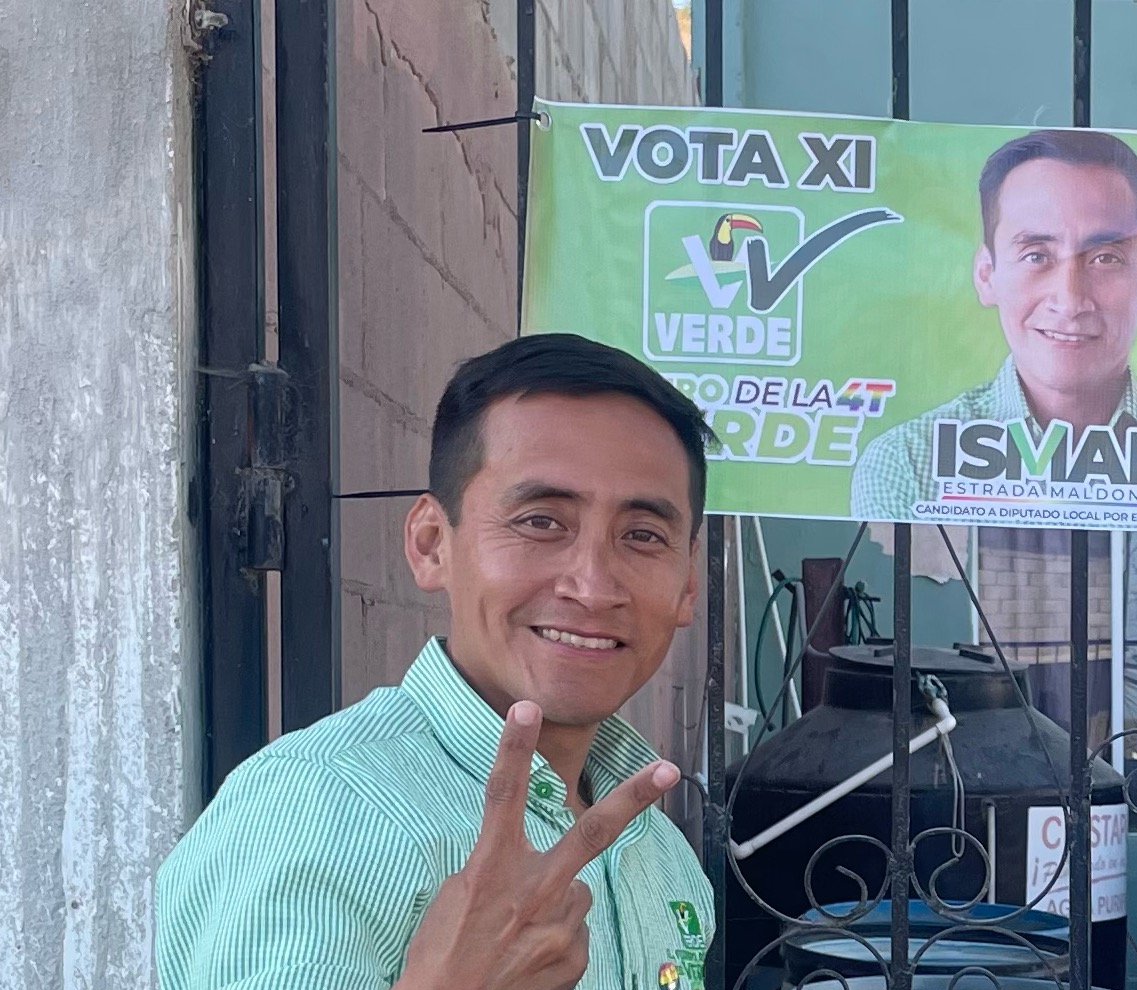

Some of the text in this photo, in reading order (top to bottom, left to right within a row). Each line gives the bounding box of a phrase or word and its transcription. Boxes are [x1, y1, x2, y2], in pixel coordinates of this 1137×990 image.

[581, 125, 873, 190] VOTA XI
[654, 313, 792, 357] VERDE
[735, 380, 783, 406] DE
[791, 383, 833, 409] LA
[836, 382, 894, 413] 4T
[704, 408, 860, 462] RDE
[943, 481, 1040, 498] ESTRADA
[915, 504, 986, 517] CANDIDATO
[988, 507, 997, 517] A
[999, 508, 1060, 520] DIPUTADO
[1062, 511, 1101, 521] LOCAL
[1103, 512, 1129, 522] POR
